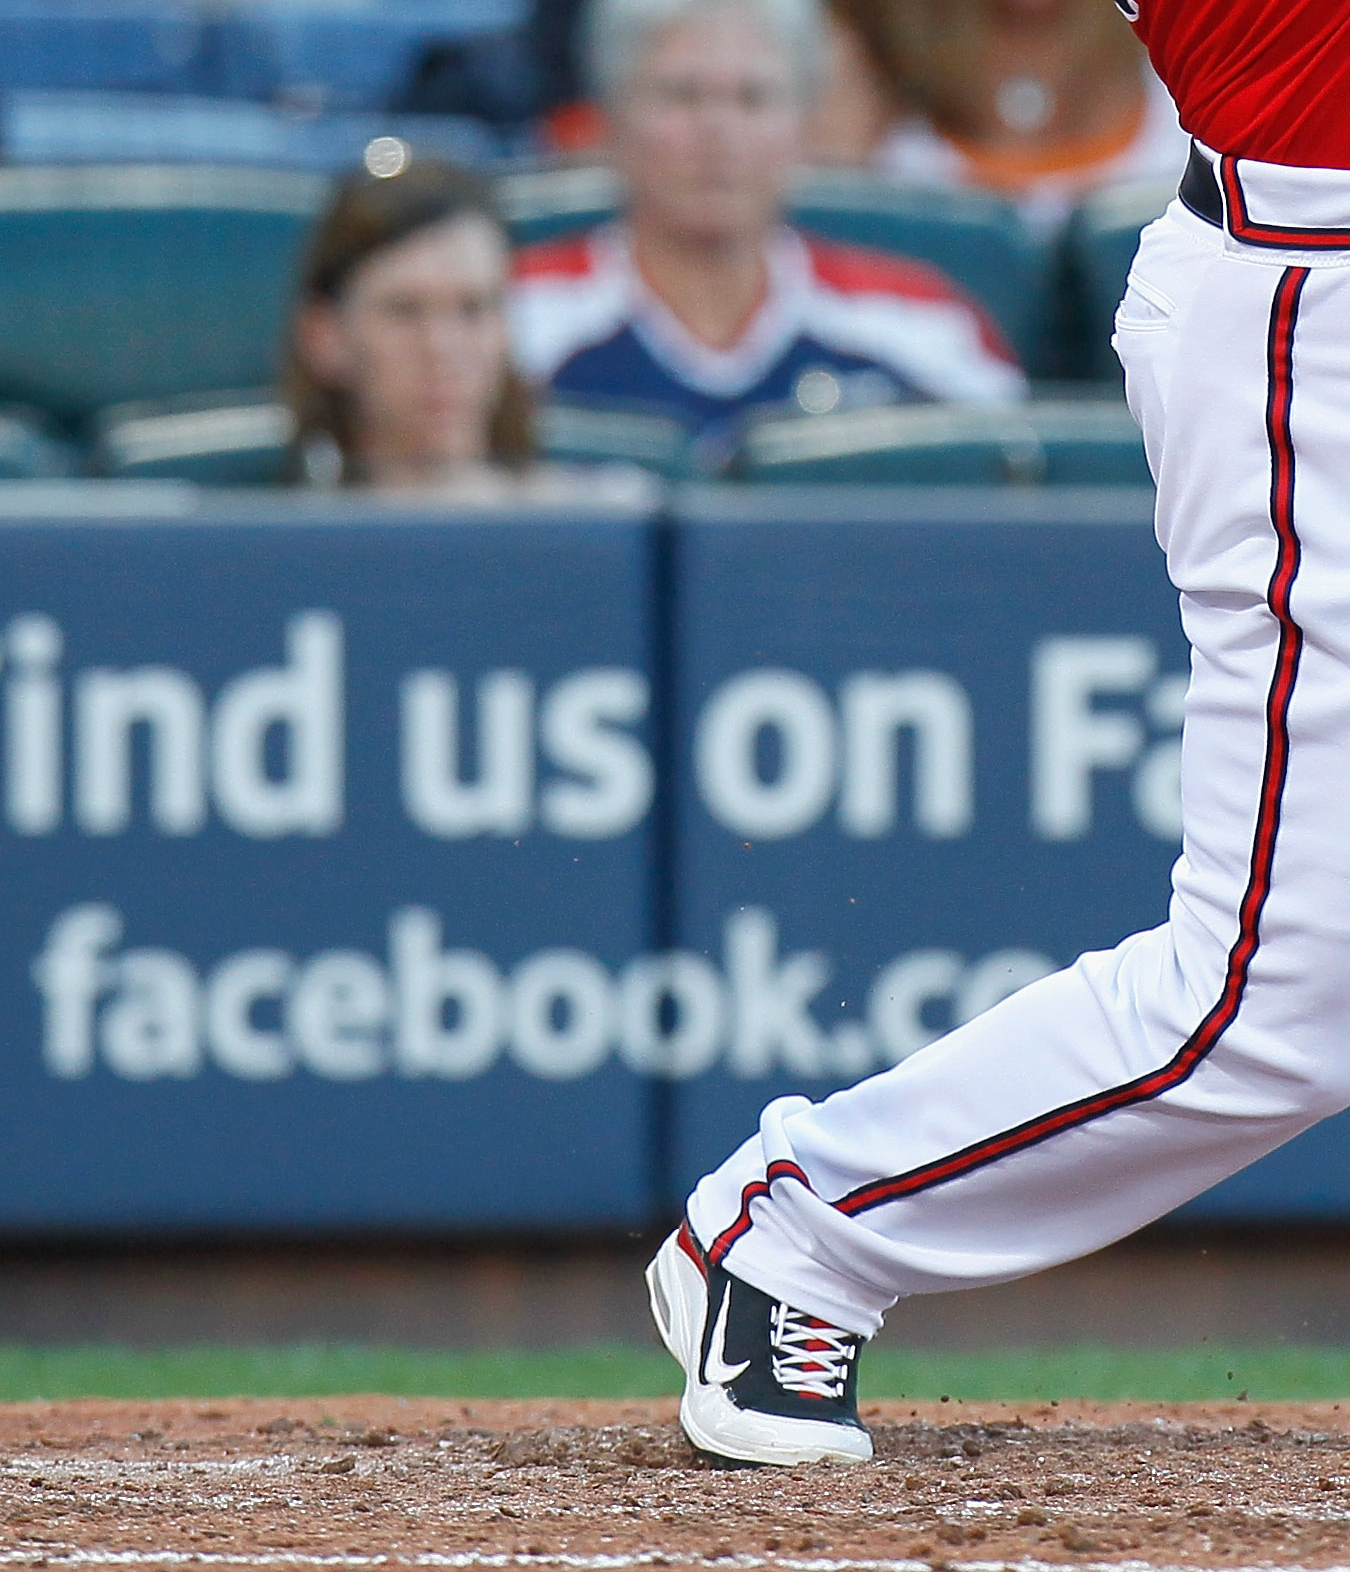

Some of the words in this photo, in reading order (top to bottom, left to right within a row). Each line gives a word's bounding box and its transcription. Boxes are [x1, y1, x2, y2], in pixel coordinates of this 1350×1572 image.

[0, 613, 345, 837] ind
[402, 668, 652, 839] us
[697, 669, 973, 840] on
